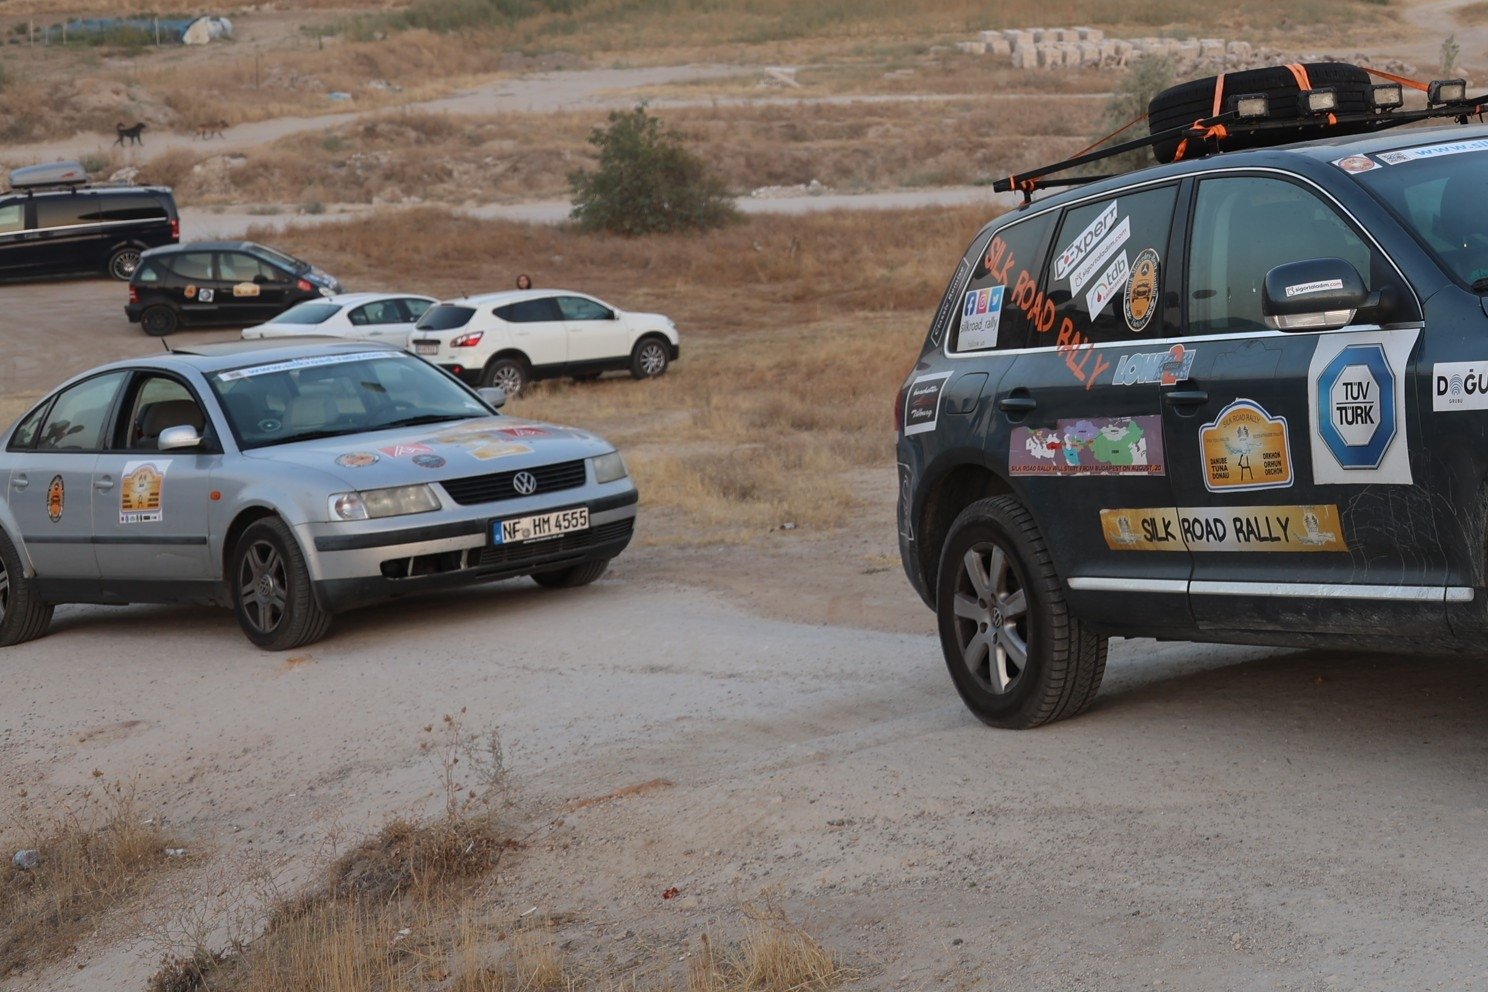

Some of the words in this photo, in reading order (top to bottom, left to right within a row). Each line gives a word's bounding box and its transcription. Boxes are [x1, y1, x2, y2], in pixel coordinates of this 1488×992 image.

[1106, 258, 1126, 286] tdb
[934, 302, 950, 336] Classic
[985, 236, 1015, 286] SILK
[1011, 269, 1056, 333] ROAD
[1056, 317, 1110, 391] RALLY
[960, 316, 998, 334] silkroad_rally
[1342, 381, 1370, 401] TÜV
[1223, 418, 1232, 428] SILK
[1232, 414, 1245, 423] ROAD
[1245, 413, 1261, 424] RALLY
[1336, 405, 1375, 426] TÜRK
[1210, 457, 1228, 465] DANUBE
[1213, 472, 1230, 480] DONAU
[503, 521, 521, 541] NF
[533, 516, 551, 536] HM
[555, 509, 587, 531] 4555
[1141, 516, 1177, 543] SILK
[1182, 516, 1226, 543] ROAD
[1233, 516, 1290, 544] RALLY
